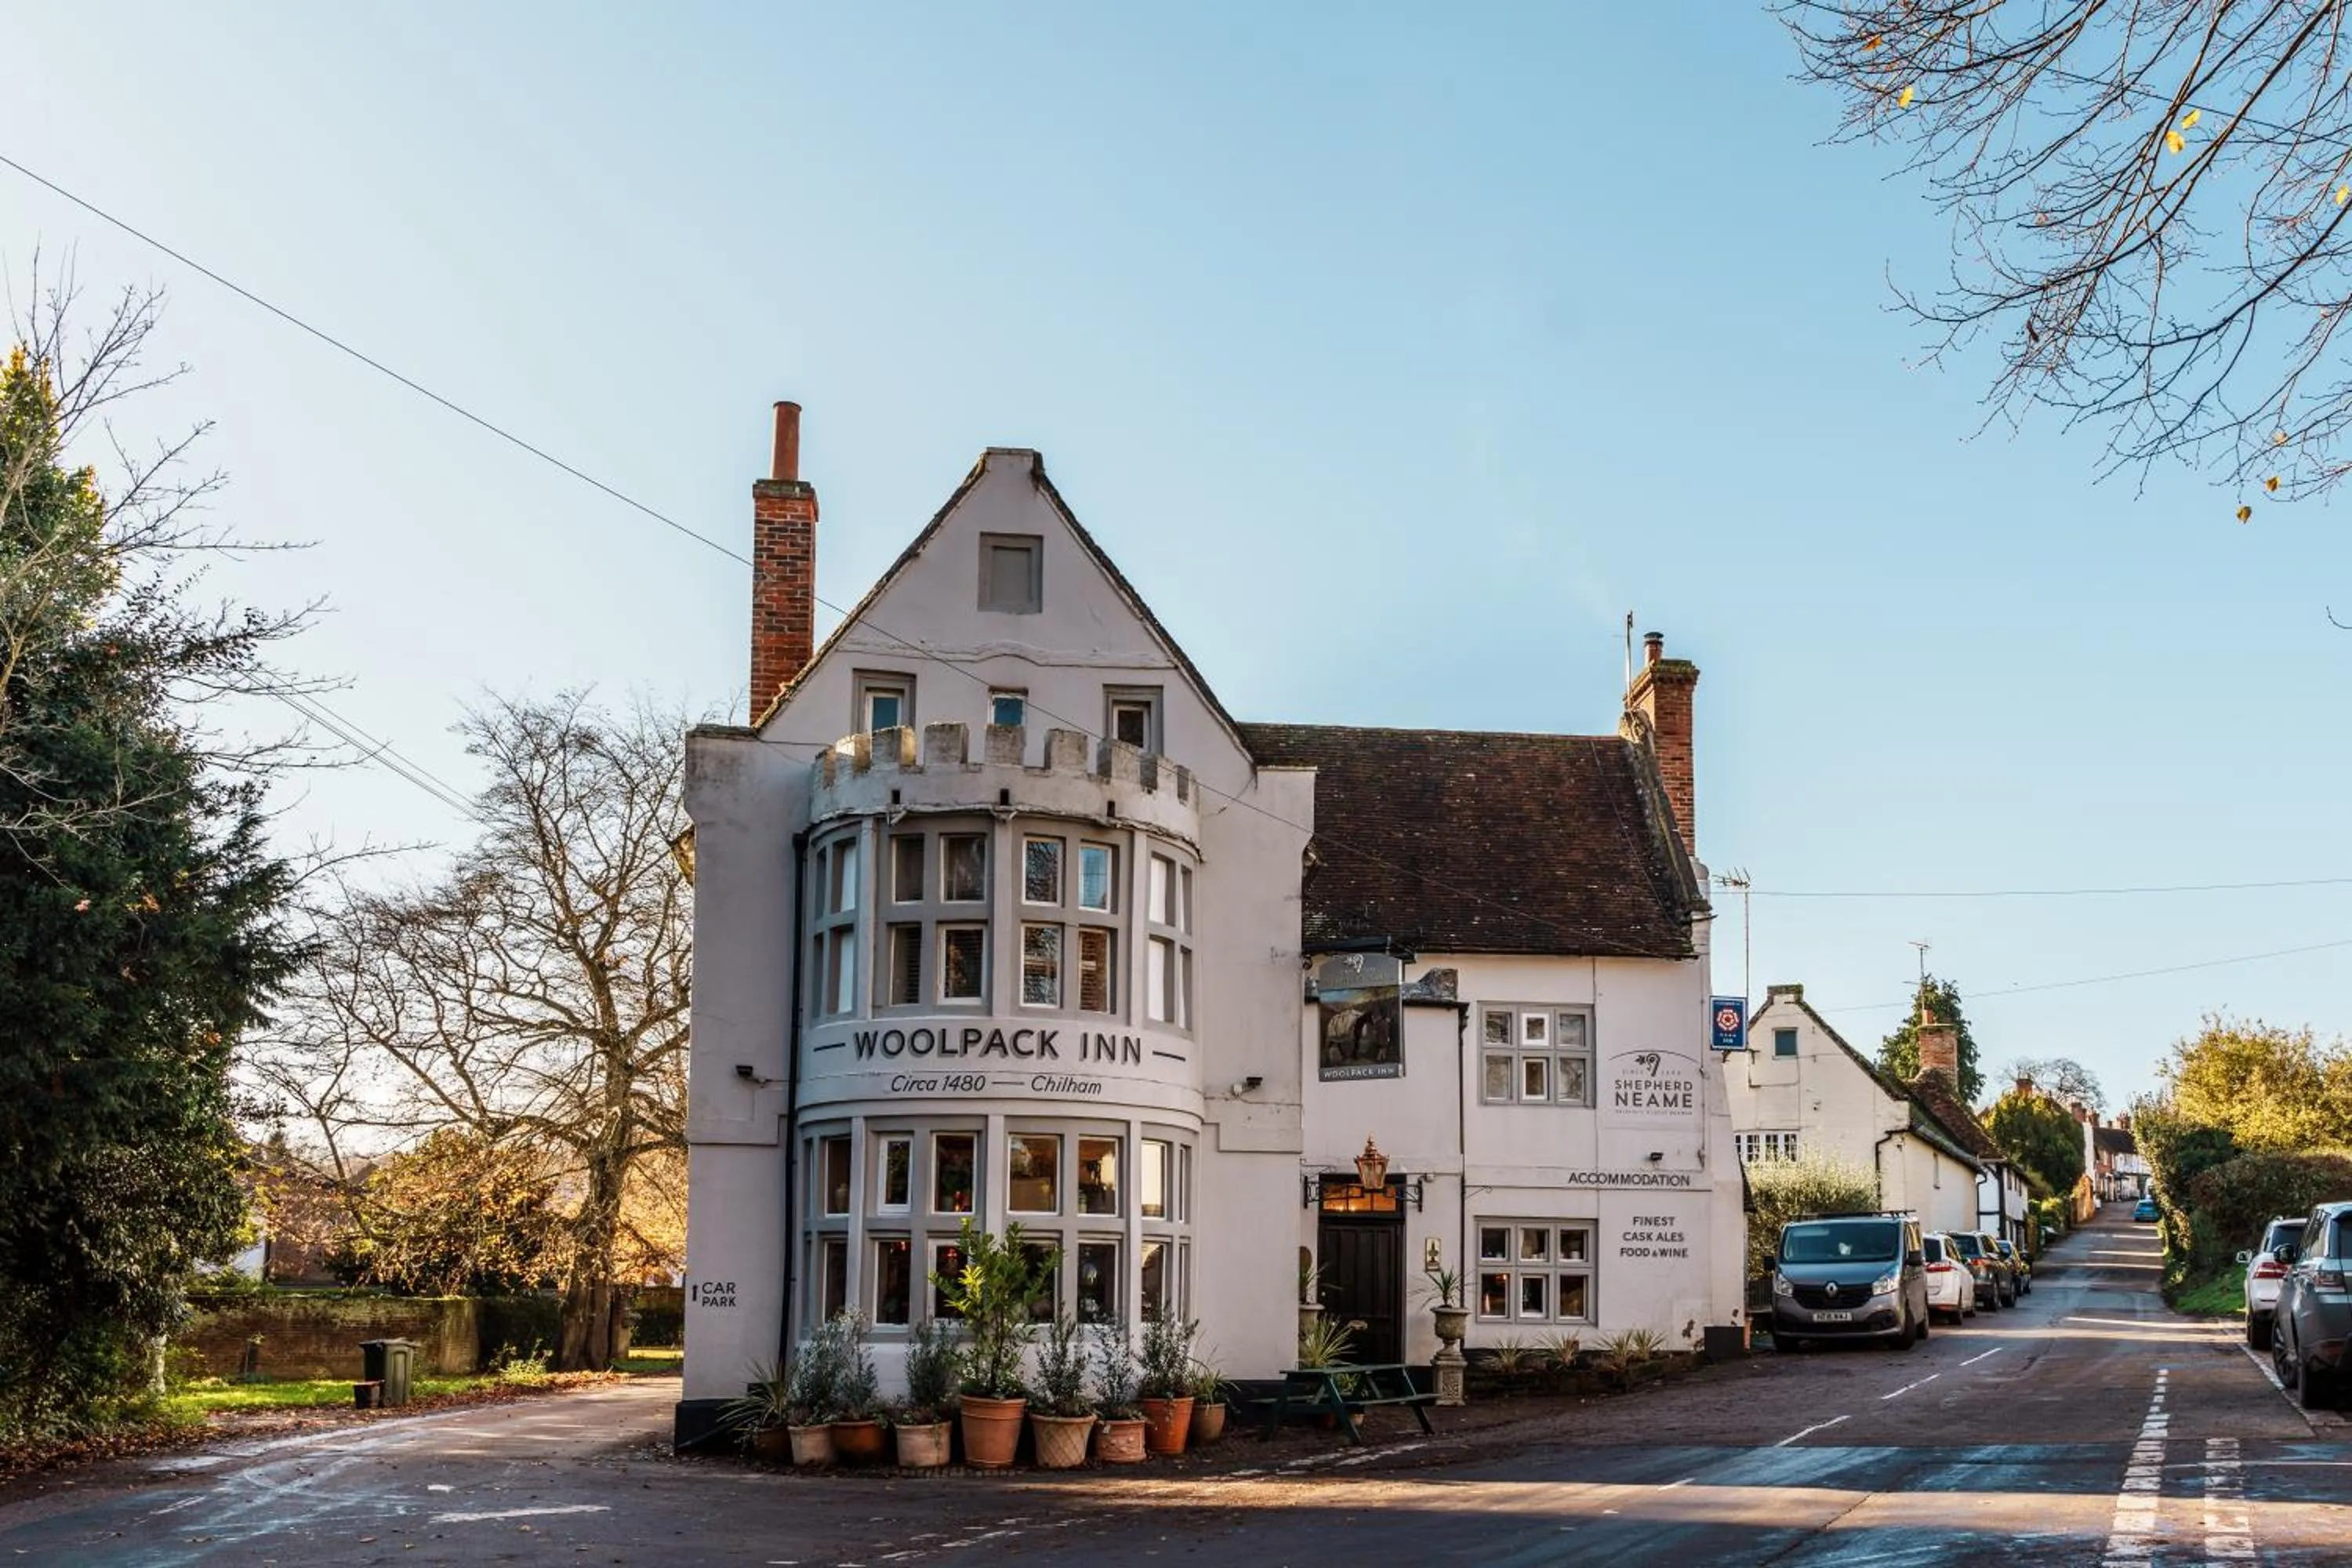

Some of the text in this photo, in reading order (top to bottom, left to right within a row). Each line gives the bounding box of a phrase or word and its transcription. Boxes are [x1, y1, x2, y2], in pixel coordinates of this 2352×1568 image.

[853, 1028, 1142, 1066] WOOLPACK INN
[891, 1075, 1102, 1094] Circa 1480 Chilham
[1614, 1079, 1693, 1091] SHEPHERD
[1615, 1091, 1693, 1108] NEAME
[1569, 1172, 1690, 1186] ACCOMMODATION
[1633, 1216, 1675, 1226] FINEST
[1622, 1232, 1684, 1242] CASK ALES
[1620, 1247, 1650, 1257] FOOD
[1658, 1248, 1689, 1258] WINE
[702, 1282, 736, 1294] CAR
[702, 1296, 736, 1307] PARK
